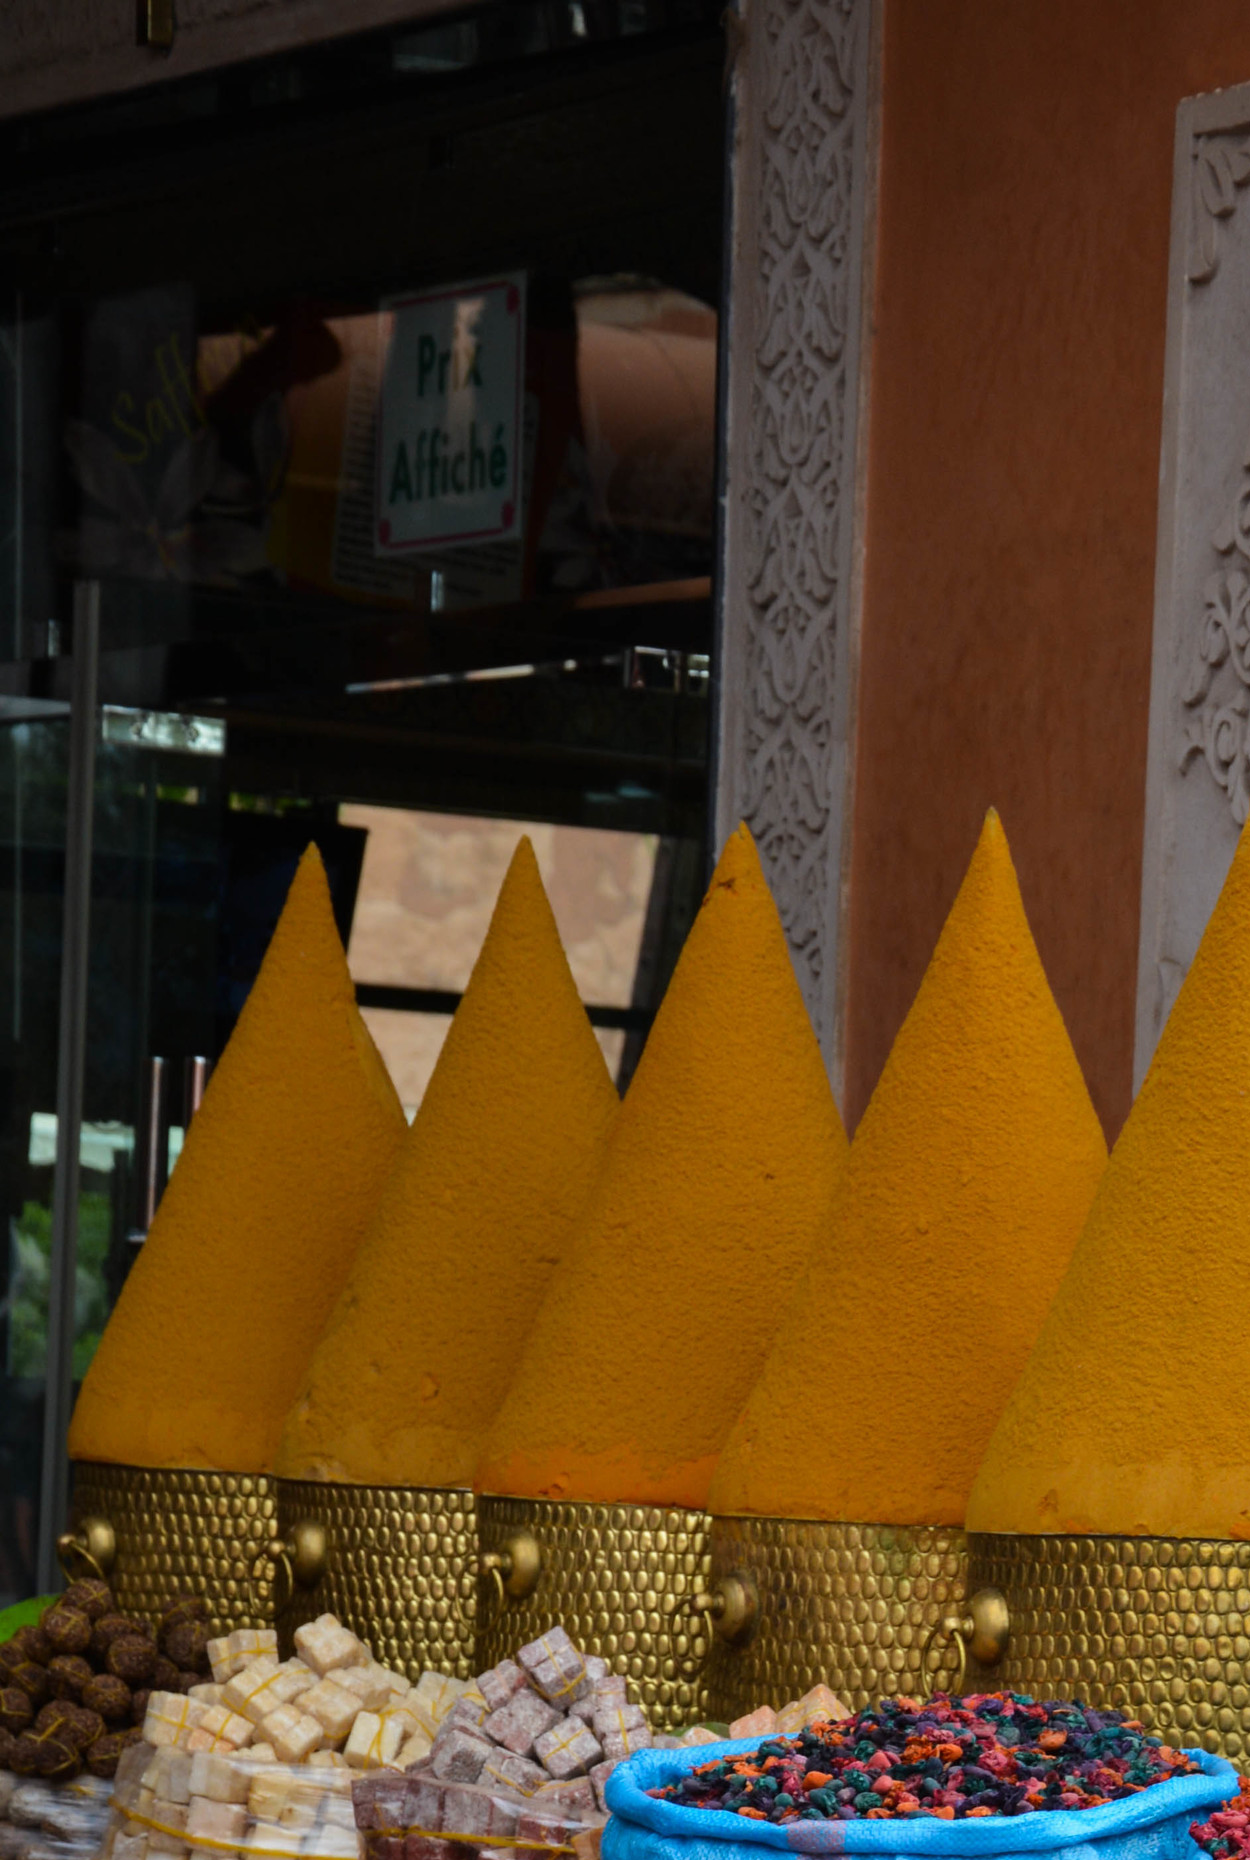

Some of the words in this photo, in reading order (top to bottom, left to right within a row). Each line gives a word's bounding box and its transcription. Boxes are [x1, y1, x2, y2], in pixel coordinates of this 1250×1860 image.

[111, 309, 267, 465] Saffn
[417, 334, 483, 397] Prix
[389, 420, 507, 504] Affiché
